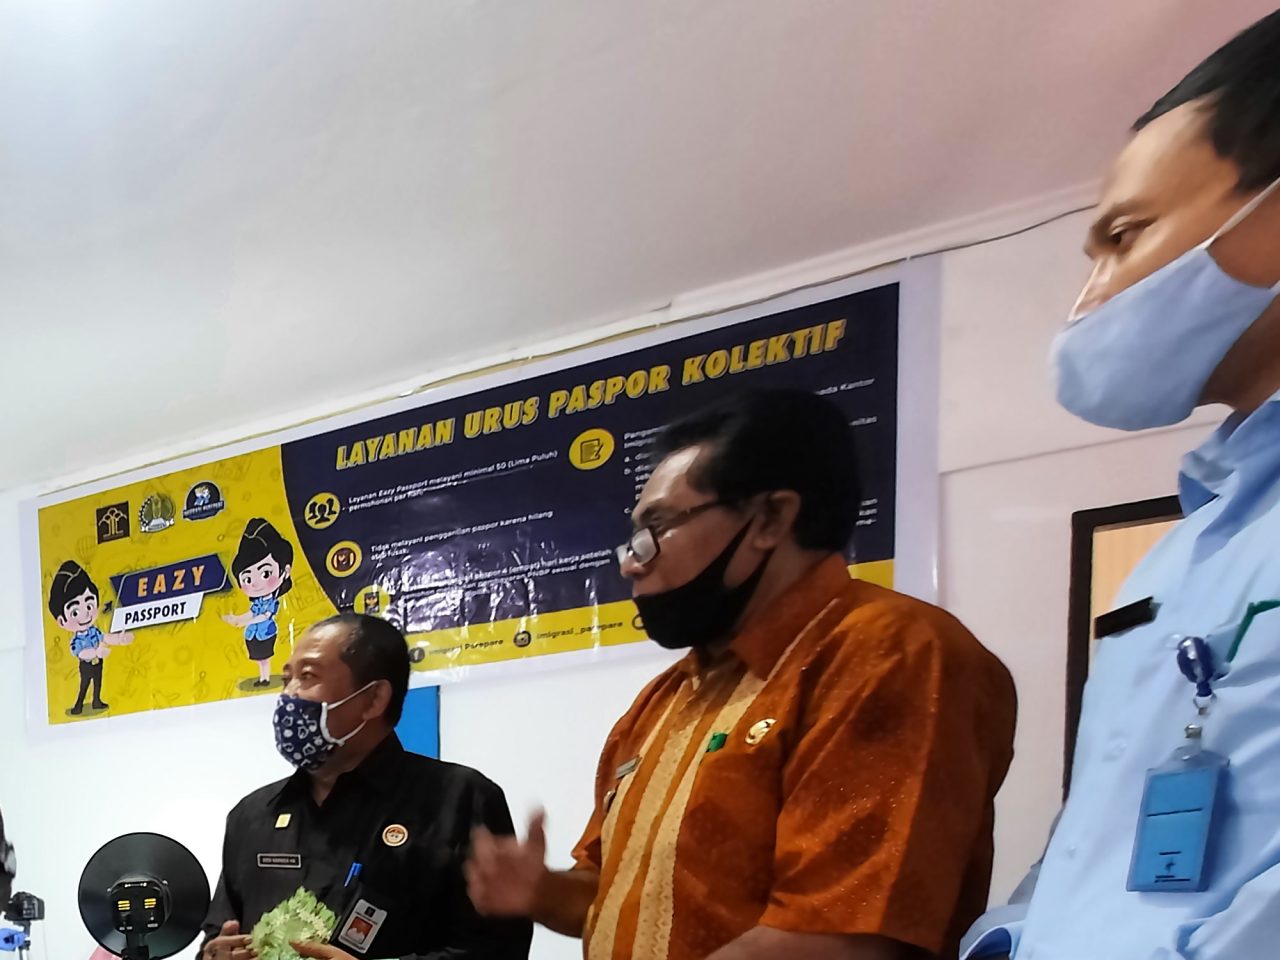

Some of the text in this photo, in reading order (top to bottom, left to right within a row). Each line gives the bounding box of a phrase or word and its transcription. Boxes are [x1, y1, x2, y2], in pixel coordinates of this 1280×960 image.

[336, 319, 848, 469] LAYANAN URUS PASPOR KOLEKTIF
[348, 490, 377, 504] Layanan
[378, 486, 395, 500] Eazy
[396, 478, 428, 494] Passport
[429, 471, 462, 487] melayani
[463, 464, 495, 478] minimal
[508, 455, 530, 470] (Lima
[531, 450, 558, 463] Puluh)
[349, 495, 393, 513] permohonan
[391, 534, 423, 548] melayani
[424, 527, 471, 544] penggantian
[471, 520, 499, 533] paspor
[500, 514, 527, 527] karena
[528, 509, 554, 521] hilang
[559, 555, 579, 564] kerja
[579, 558, 610, 570] dengan
[137, 565, 205, 598] EAZY
[124, 601, 186, 625] PASSPORT
